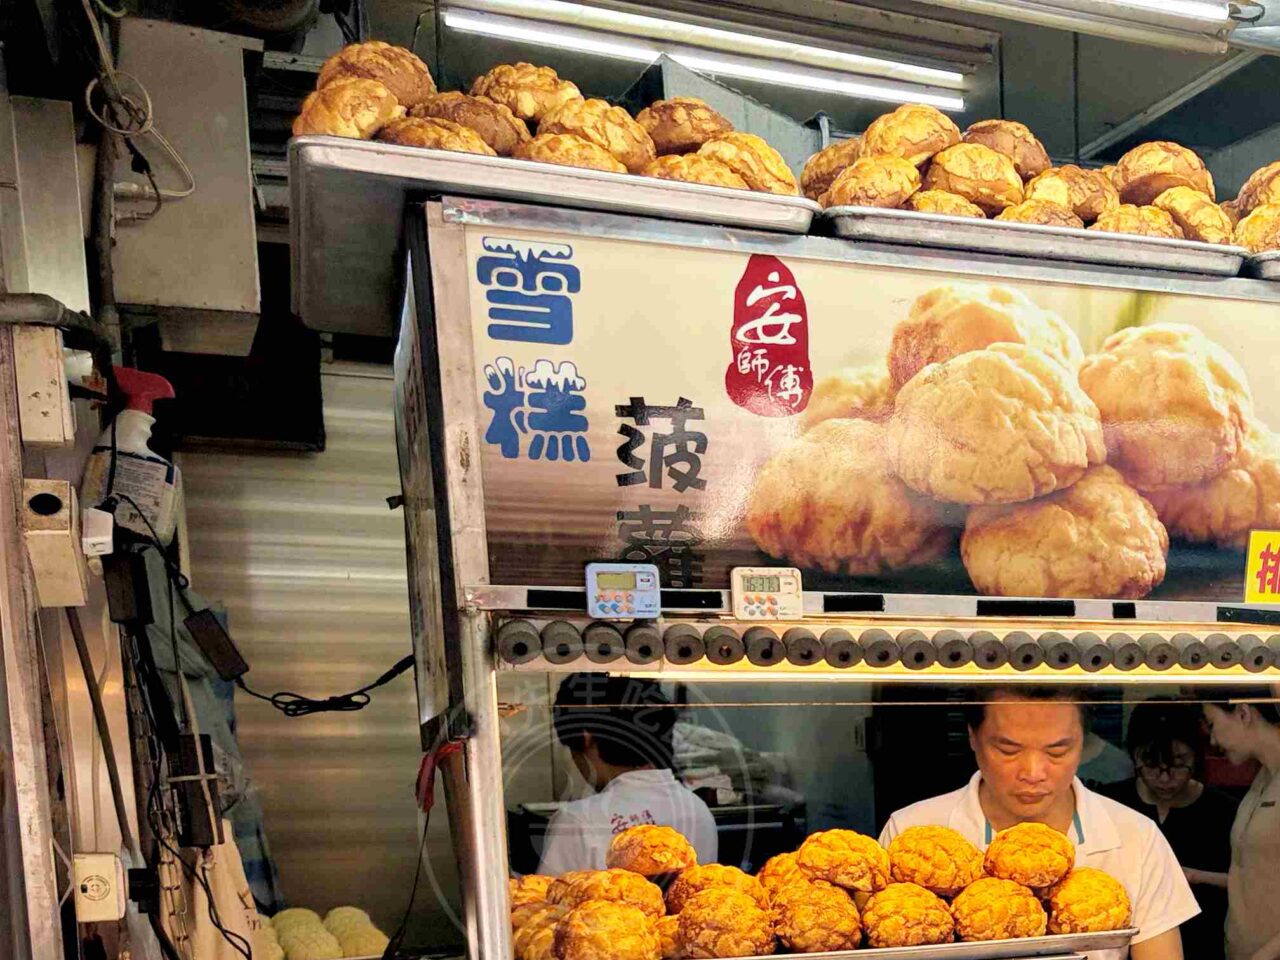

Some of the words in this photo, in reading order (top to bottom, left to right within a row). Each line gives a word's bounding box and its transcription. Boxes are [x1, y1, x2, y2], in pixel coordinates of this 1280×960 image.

[476, 235, 592, 463] 雪糕
[735, 271, 804, 408] 安師傅
